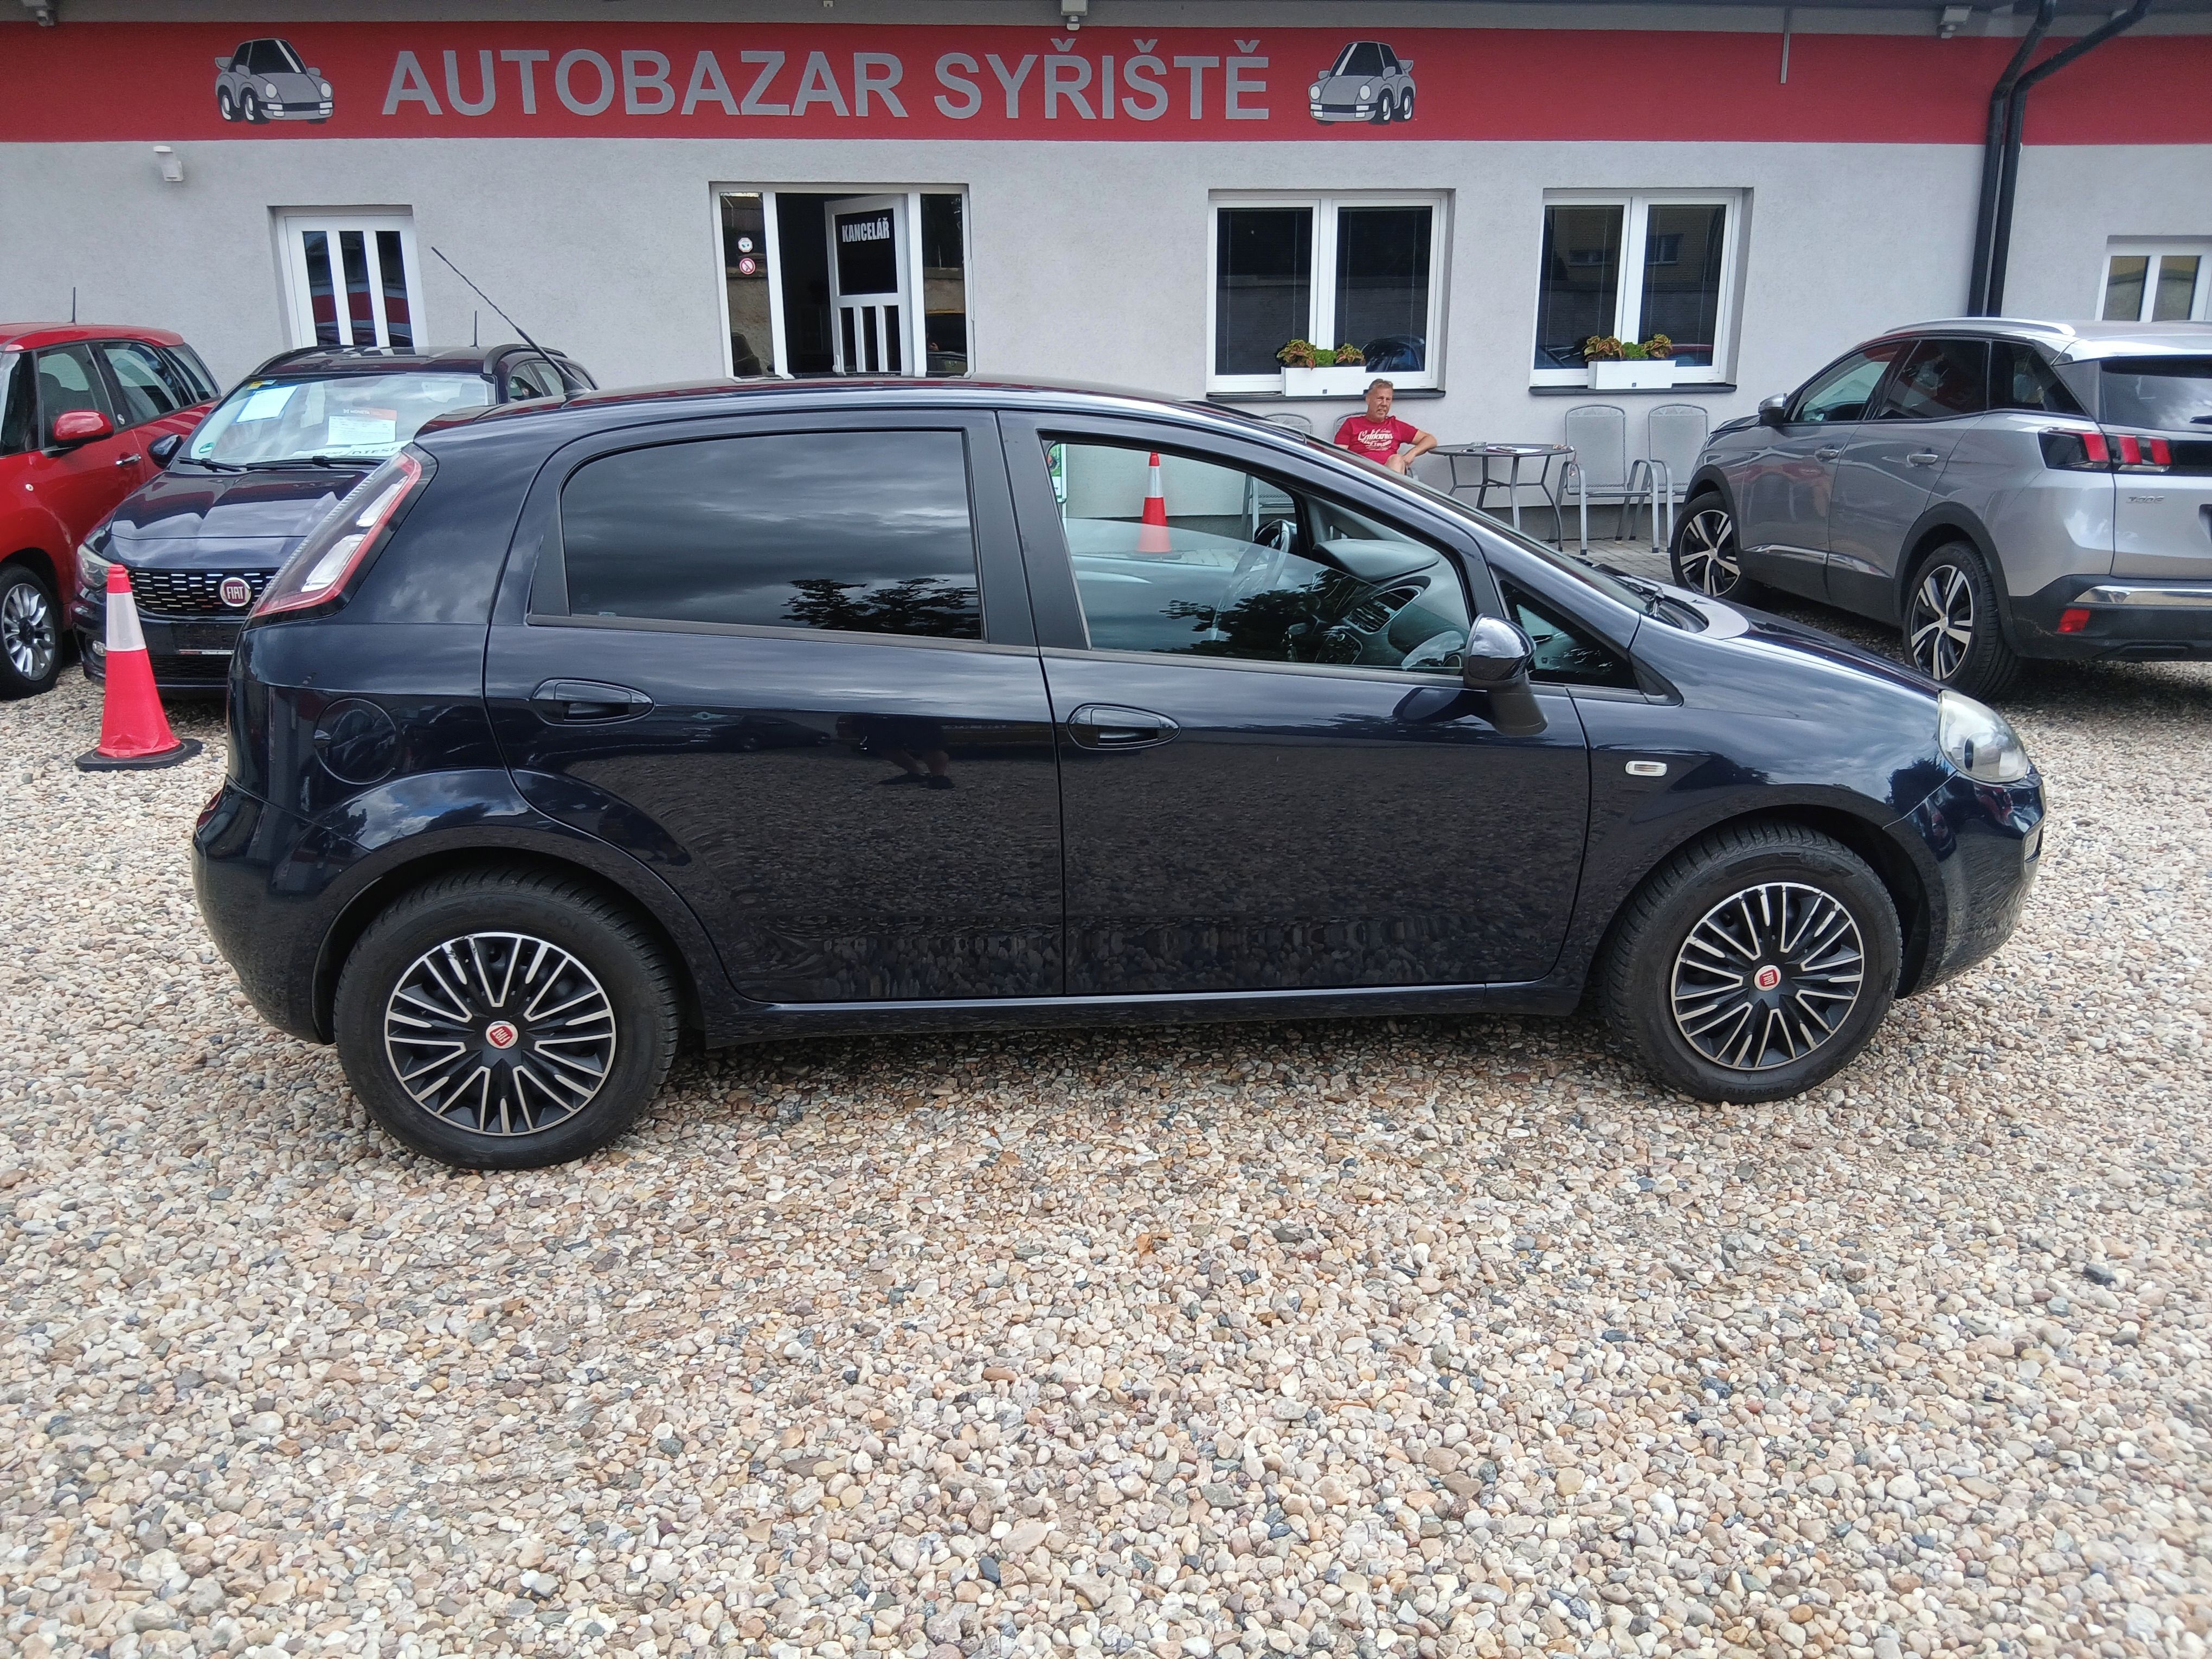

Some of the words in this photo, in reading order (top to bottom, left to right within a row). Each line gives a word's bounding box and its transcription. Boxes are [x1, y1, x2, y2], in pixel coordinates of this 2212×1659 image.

[382, 49, 908, 117] AUTOBAZAR
[934, 38, 1269, 121] SYŘIŠTĚ
[841, 217, 890, 242] KANCELÁŘ
[352, 446, 399, 455] DIESE
[226, 586, 243, 600] FIAT
[1762, 971, 1775, 986] FIAT
[491, 1027, 511, 1044] FIAT
